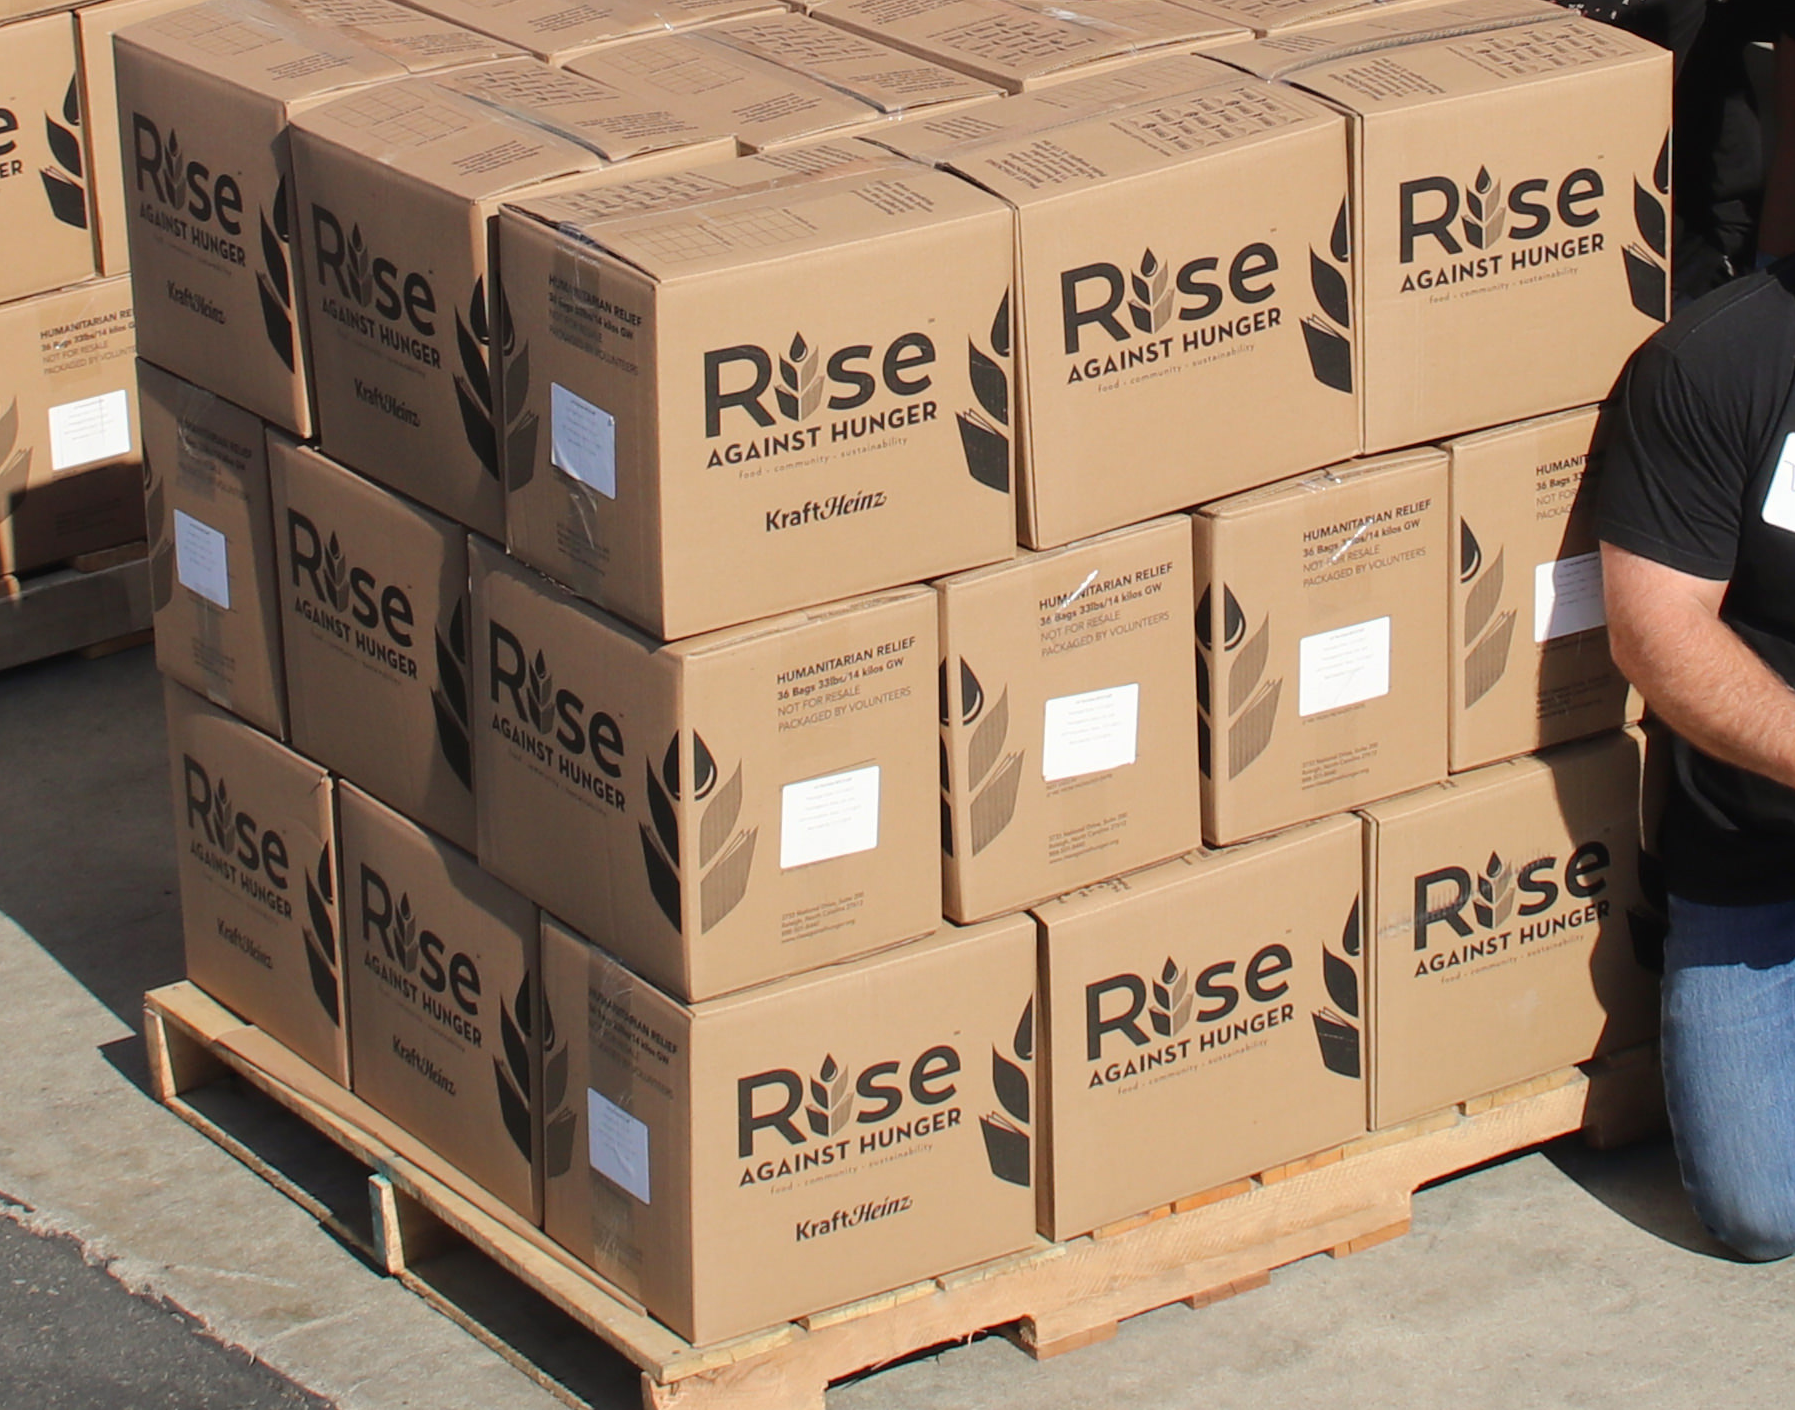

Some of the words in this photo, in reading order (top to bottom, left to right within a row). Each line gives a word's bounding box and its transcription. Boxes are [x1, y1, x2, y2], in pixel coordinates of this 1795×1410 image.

[133, 111, 243, 237] Rise
[1399, 165, 1606, 264] Rise
[140, 201, 188, 246] AGAINST
[190, 227, 246, 268] HUNGER
[312, 201, 438, 338] Rise
[1400, 256, 1502, 294] AGAINST
[1511, 233, 1606, 271] HUNGER
[322, 295, 376, 341] AGAINST
[379, 324, 442, 370] HUNGER
[1060, 242, 1280, 356] Rise
[704, 331, 937, 438] Rise
[1067, 339, 1174, 385] AGAINST
[1183, 307, 1282, 352] HUNGER
[706, 425, 823, 470] AGAINST
[831, 401, 937, 443] HUNGER
[288, 507, 415, 650] Rise
[1040, 616, 1052, 627] 36
[1054, 610, 1077, 622] Bags
[1121, 589, 1143, 603] kilos
[1144, 582, 1163, 596] GW
[1135, 562, 1173, 583] RELIEF
[295, 595, 351, 644] AGAINST
[353, 624, 418, 681] HUNGER
[777, 648, 874, 685] HUMANITARIAN
[877, 636, 916, 657] RELIEF
[1040, 627, 1061, 642] NOT
[1064, 621, 1085, 634] FOR
[1087, 610, 1121, 628] RESALE
[1042, 634, 1094, 657] PACKAGED
[1095, 629, 1108, 642] BY
[1110, 611, 1170, 637] VOLUNTEERS
[489, 618, 626, 779] Rise
[777, 690, 790, 701] 36
[792, 685, 816, 697] Bags
[862, 664, 884, 677] kilos
[886, 657, 904, 670] GW
[777, 702, 800, 717] NOT
[803, 696, 823, 709] FOR
[825, 685, 861, 702] RESALE
[778, 710, 832, 732] PACKAGED
[834, 705, 847, 717] BY
[849, 686, 912, 712] VOLUNTEERS
[492, 712, 555, 768] AGAINST
[559, 757, 627, 813] HUNGER
[183, 751, 290, 892] Rise
[190, 837, 237, 884] AGAINST
[239, 871, 293, 922] HUNGER
[1414, 840, 1612, 951] Rise
[360, 862, 482, 1017] Rise
[1414, 932, 1512, 978] AGAINST
[1520, 901, 1612, 945] HUNGER
[364, 949, 418, 1003] AGAINST
[422, 992, 483, 1050] HUNGER
[1086, 943, 1294, 1062] Rise
[1088, 1040, 1191, 1089] AGAINST
[1199, 1004, 1295, 1051] HUNGER
[738, 1044, 962, 1159] Rise
[739, 1141, 851, 1188] AGAINST
[860, 1107, 962, 1155] HUNGER
